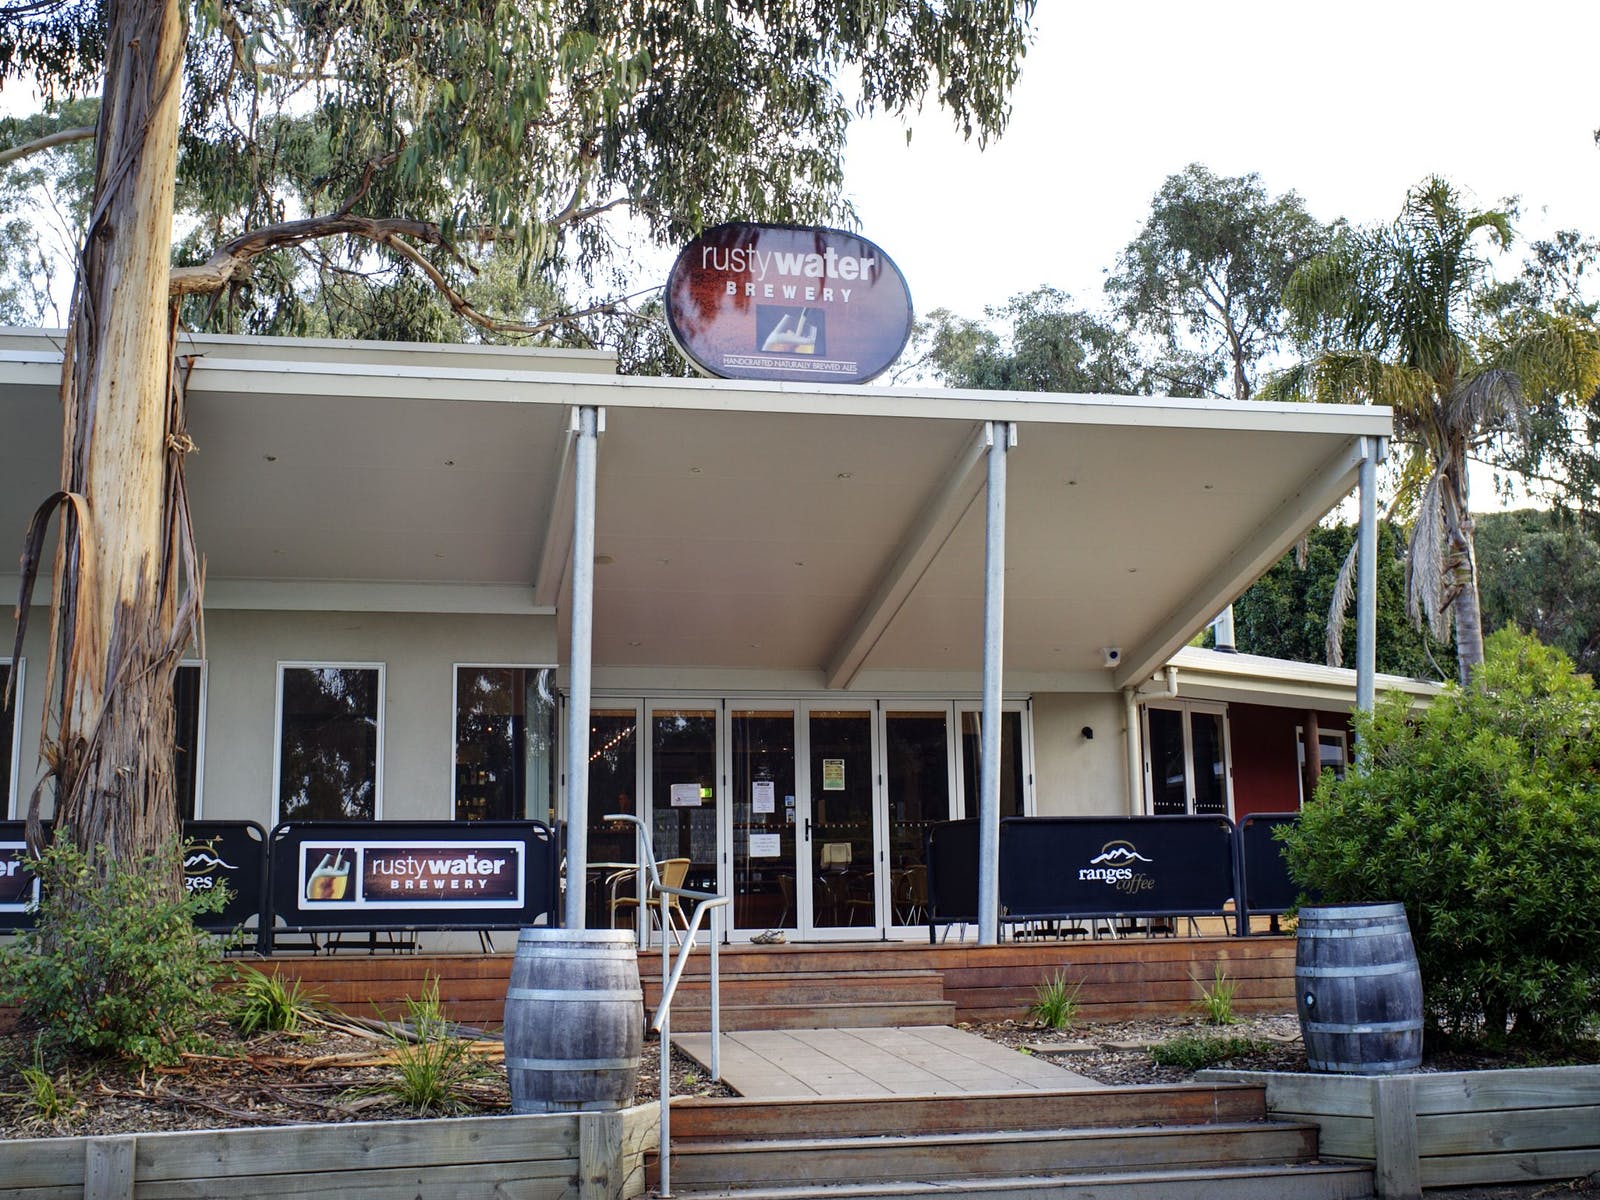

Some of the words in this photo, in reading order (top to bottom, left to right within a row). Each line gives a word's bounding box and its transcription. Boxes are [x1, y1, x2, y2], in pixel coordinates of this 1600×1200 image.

[726, 281, 852, 303] BREWERY
[724, 358, 772, 368] HANDCRAFTED
[774, 360, 810, 370] NATURALLY
[812, 362, 840, 371] BREWED
[842, 364, 858, 372] ALES
[184, 876, 212, 892] ges
[1079, 868, 1132, 884] ranges
[1116, 873, 1154, 894] coffee
[391, 880, 488, 889] BREWERY
